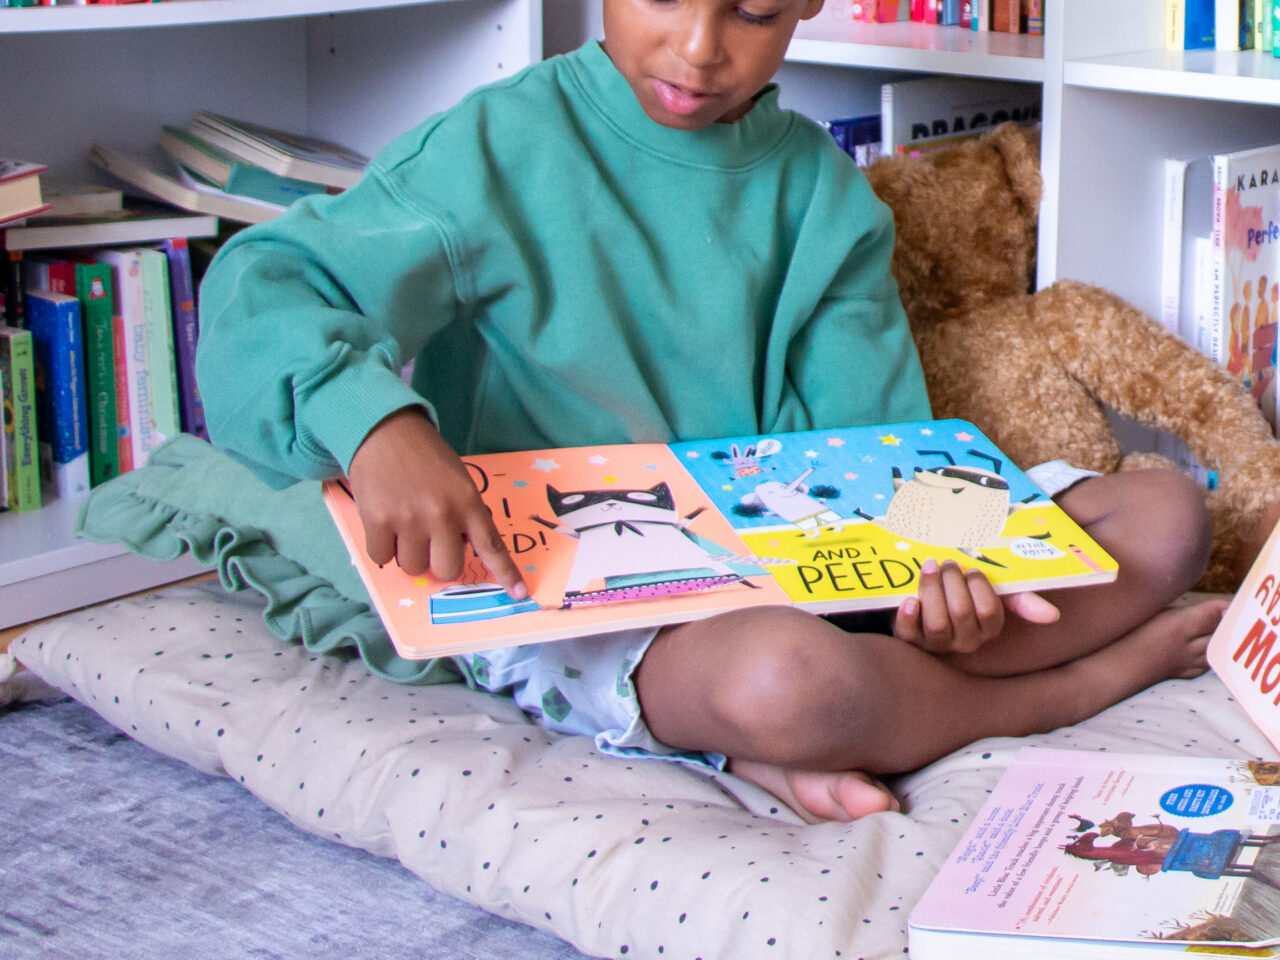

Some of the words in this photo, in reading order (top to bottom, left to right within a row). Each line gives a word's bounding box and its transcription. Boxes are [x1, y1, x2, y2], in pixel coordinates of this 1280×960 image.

[1213, 284, 1221, 333] PERFECTLY
[132, 323, 148, 363] baby
[136, 369, 154, 452] feminists
[16, 404, 33, 468] Everything
[811, 545, 861, 562] AND
[870, 545, 877, 556] I
